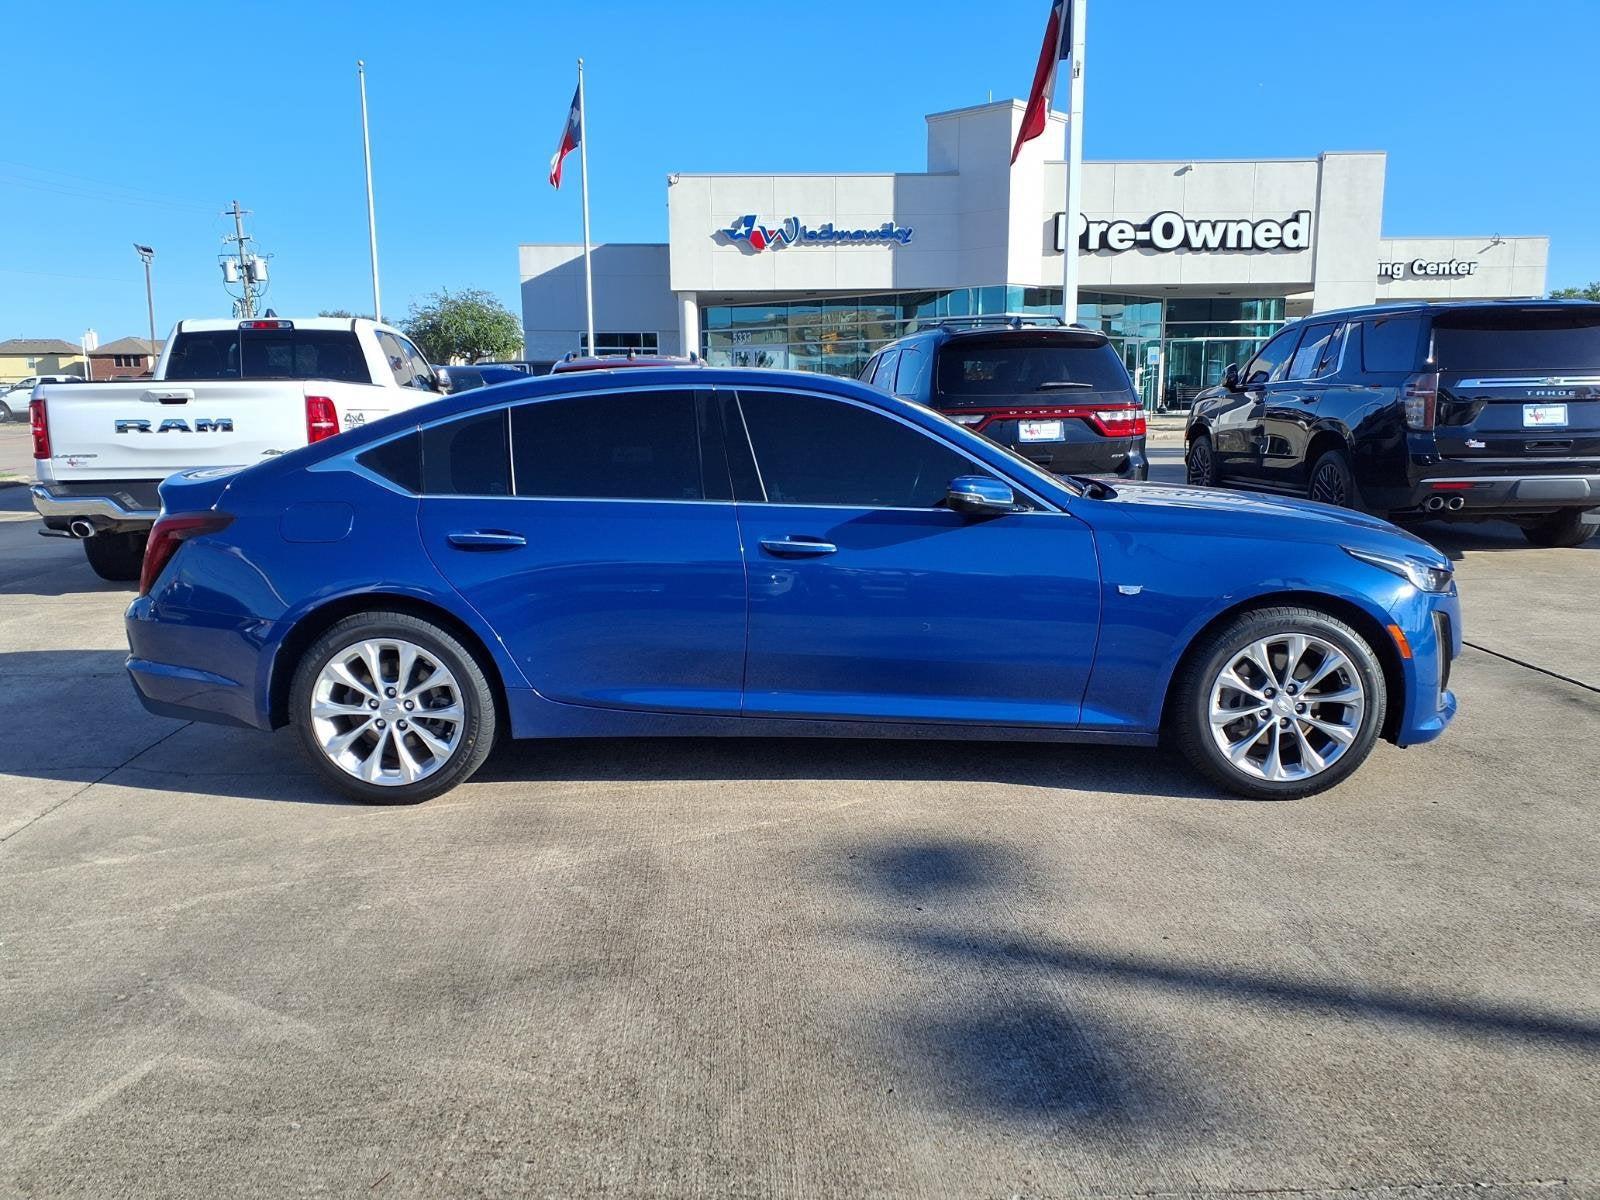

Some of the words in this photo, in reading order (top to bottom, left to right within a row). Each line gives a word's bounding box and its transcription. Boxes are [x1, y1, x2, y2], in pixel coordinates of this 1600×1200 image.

[757, 216, 913, 245] Wischnewsky
[1054, 210, 1311, 252] Pre-Owned
[1377, 260, 1405, 280] ing
[1411, 259, 1478, 276] Center
[732, 332, 752, 344] 5333
[115, 418, 234, 434] RAM
